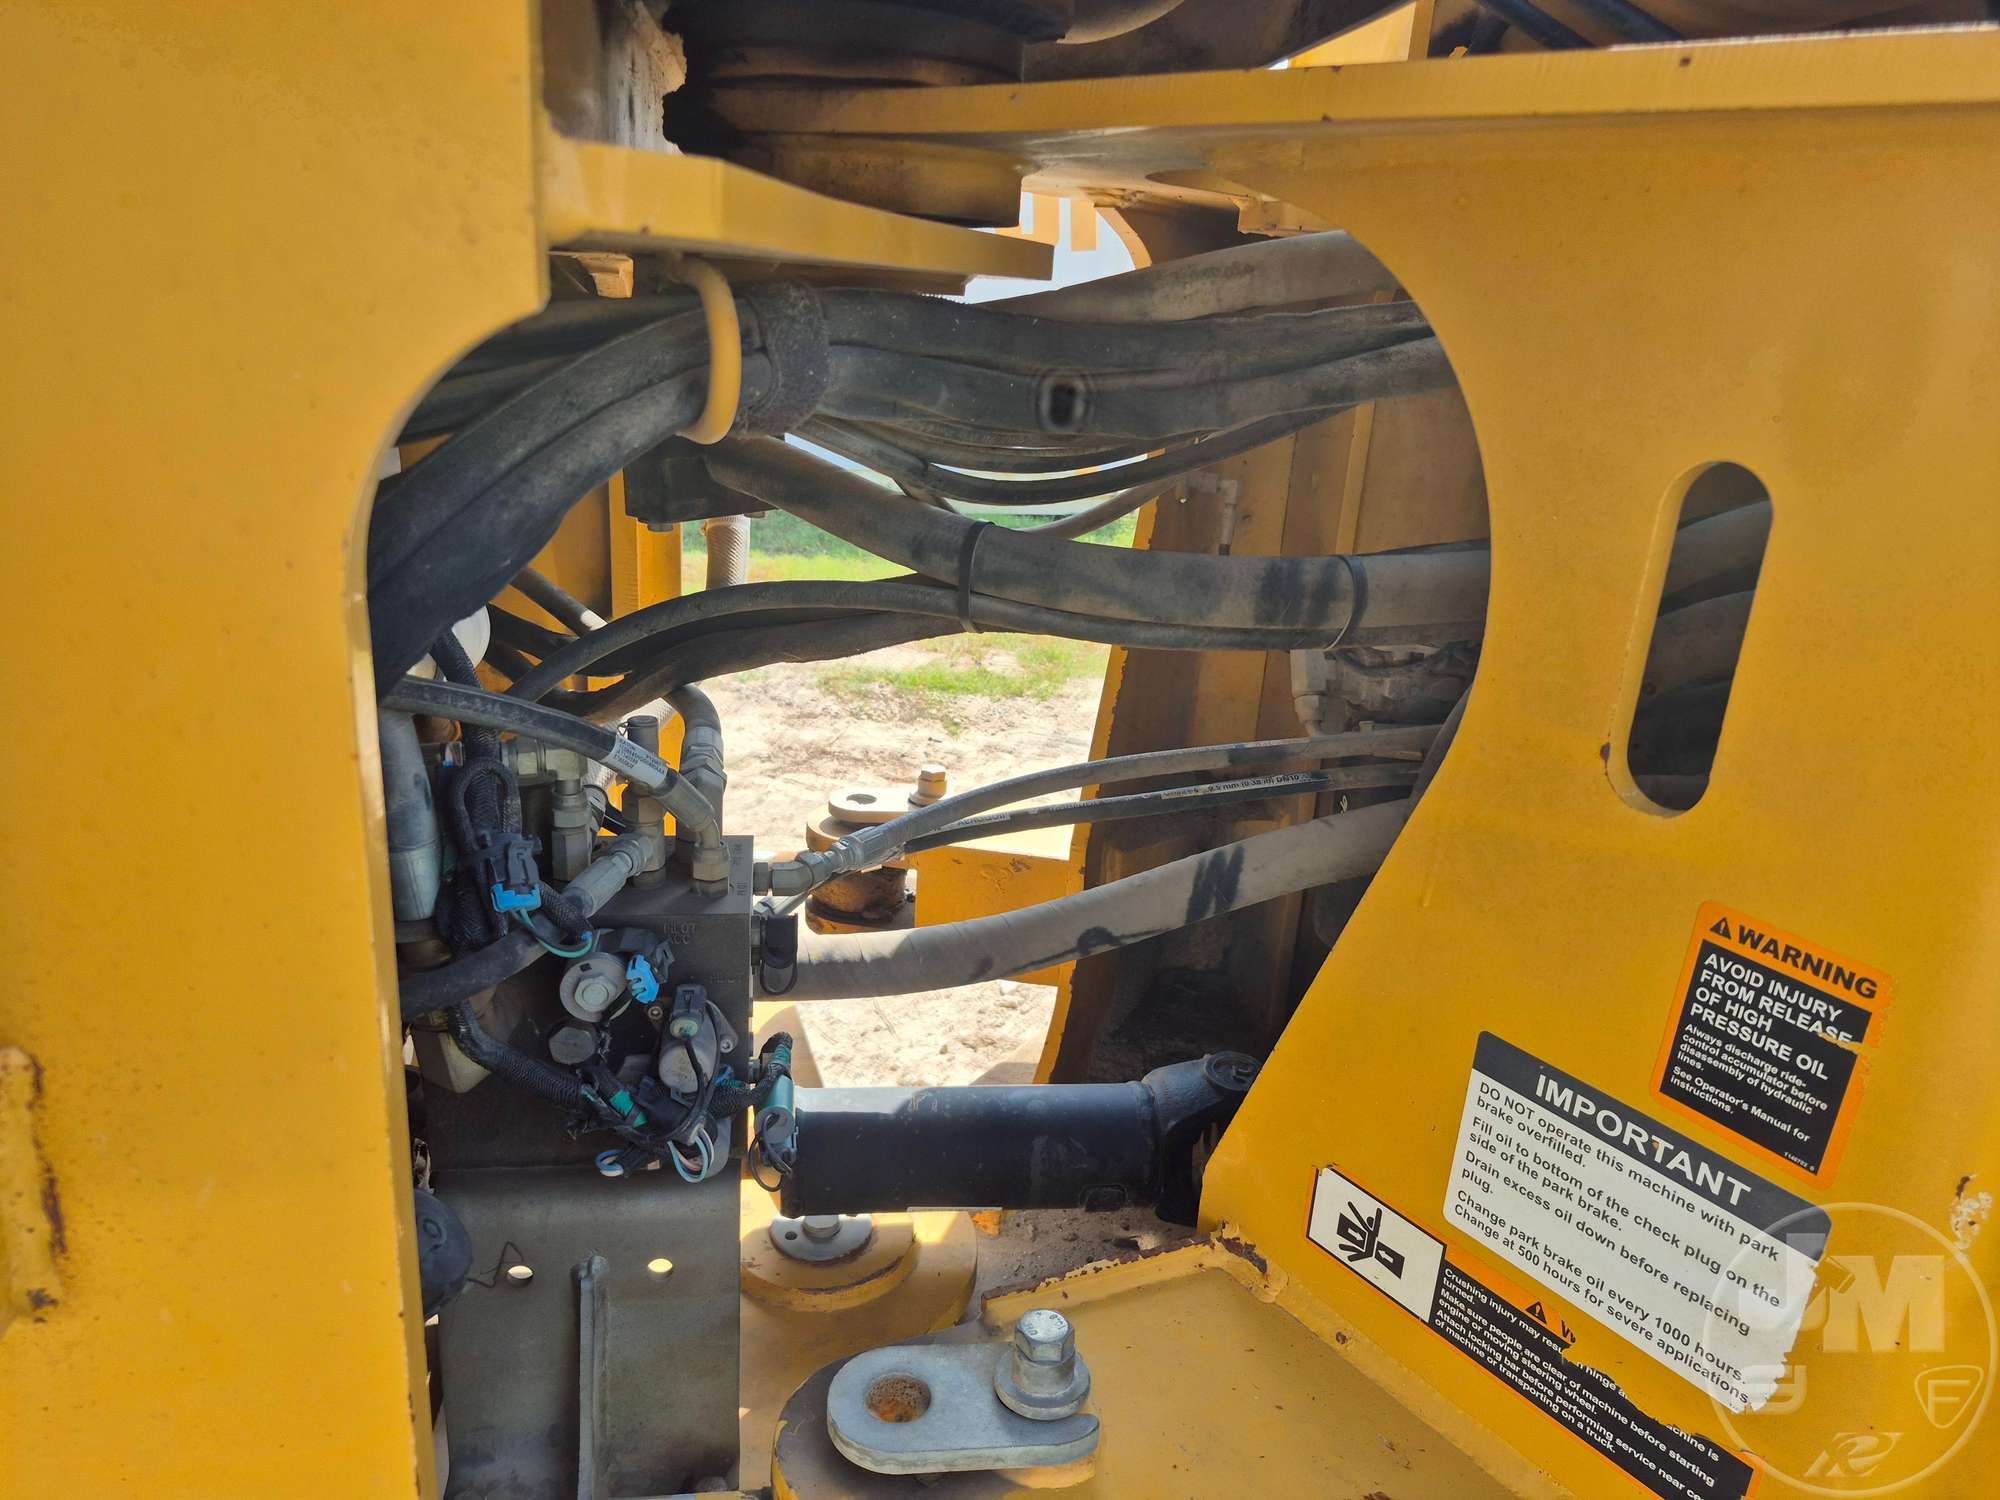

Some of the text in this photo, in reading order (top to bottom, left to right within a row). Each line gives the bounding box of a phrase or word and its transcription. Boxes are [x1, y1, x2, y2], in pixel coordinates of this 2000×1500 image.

[1704, 953, 1843, 1023] AVOID INJURY
[1738, 925, 1878, 999] WARNING
[1690, 1002, 1829, 1081] PRESSURE OIL
[1696, 986, 1773, 1033] OF HIGH
[1700, 968, 1853, 1047] FROM RELEASE
[1670, 1074, 1733, 1115] instructions.
[1677, 1050, 1704, 1071] lines.
[1678, 1043, 1813, 1115] disassembly of hydraulic
[1682, 1034, 1828, 1111] control accumulator before
[1684, 1024, 1807, 1087] Always discharge ride-
[1477, 1096, 1586, 1168] brake overfilled.
[1536, 1074, 1752, 1206] IMPORTANT
[1672, 1066, 1811, 1142] See Operator's Manual for
[1462, 1168, 1494, 1195] plug.
[1470, 1133, 1621, 1231] side of the park brake.
[1480, 1082, 1779, 1261] DO NOT operate this machine with park
[1466, 1150, 1750, 1337] Drain excess oil down before replacing
[1472, 1116, 1779, 1307] Fill oil to bottom of the check plug on the
[1443, 1277, 1475, 1305] turned.
[1454, 1204, 1499, 1240] Change
[1502, 1238, 1515, 1251] at
[1518, 1245, 1539, 1266] 500
[1543, 1261, 1581, 1293] hours
[1584, 1288, 1604, 1307] for
[1606, 1306, 1653, 1341] severe
[1656, 1338, 1749, 1403] applications
[1458, 1190, 1745, 1384] Change park brake oil every 1000 hours.
[1434, 1318, 1616, 1453] of machine or transporting on a truck.
[1438, 1298, 1597, 1415] engine or moving steering wheel.
[1440, 1288, 1715, 1488] Make sure people are clear of machine before starting
[1444, 1268, 1488, 1304] Crushing
[1489, 1298, 1517, 1323] injury
[1518, 1320, 1541, 1339] may
[1708, 1448, 1719, 1462] is
[1436, 1309, 1467, 1335] Attach
[1468, 1330, 1503, 1362] locking
[1504, 1356, 1521, 1373] bar
[1522, 1369, 1554, 1397] before
[1555, 1395, 1614, 1443] performing
[1615, 1438, 1657, 1471] service
[1658, 1468, 1685, 1491] near
